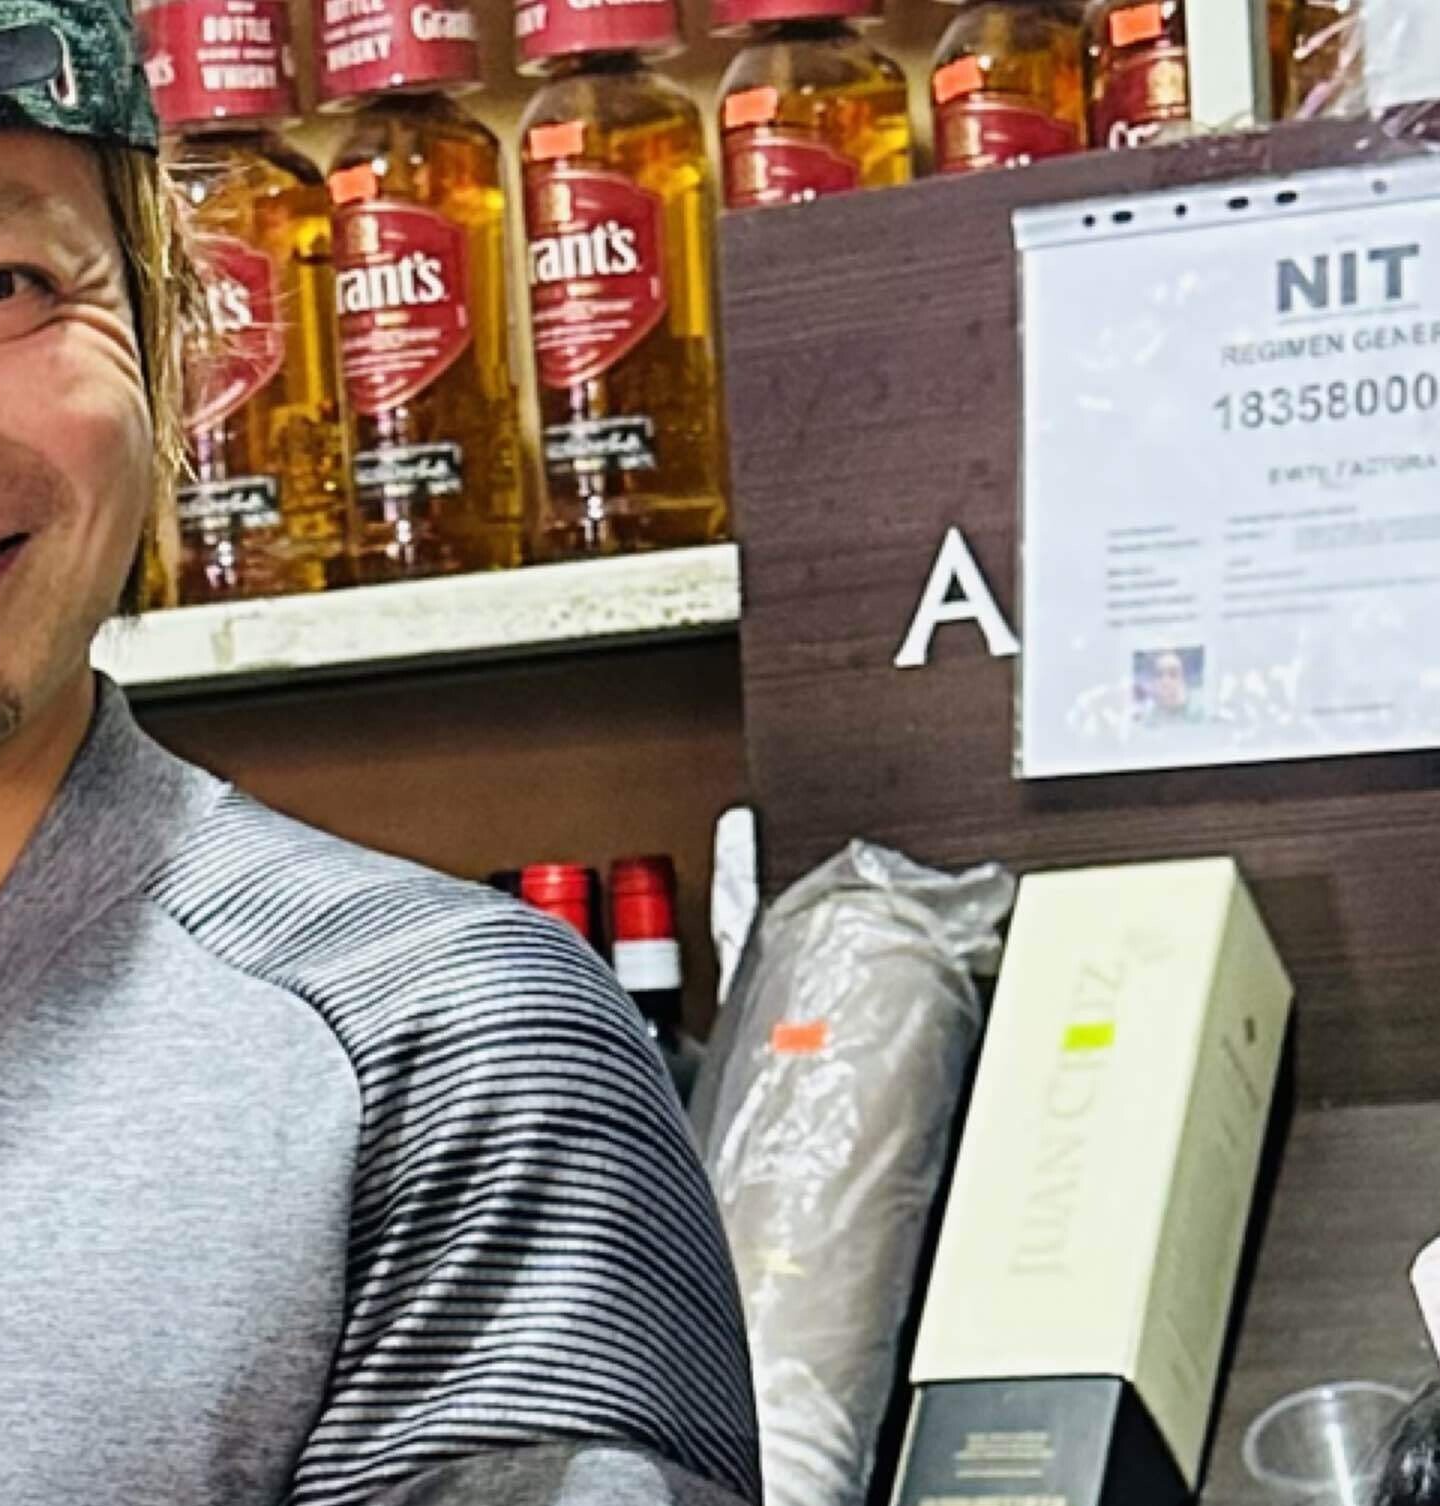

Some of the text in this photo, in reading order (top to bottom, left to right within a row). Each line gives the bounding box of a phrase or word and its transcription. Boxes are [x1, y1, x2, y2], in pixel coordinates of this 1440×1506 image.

[337, 251, 448, 315] rant's
[530, 220, 641, 285] rant's
[1276, 243, 1421, 314] NIT
[1221, 333, 1346, 368] REGIMEN
[895, 526, 1019, 667] A
